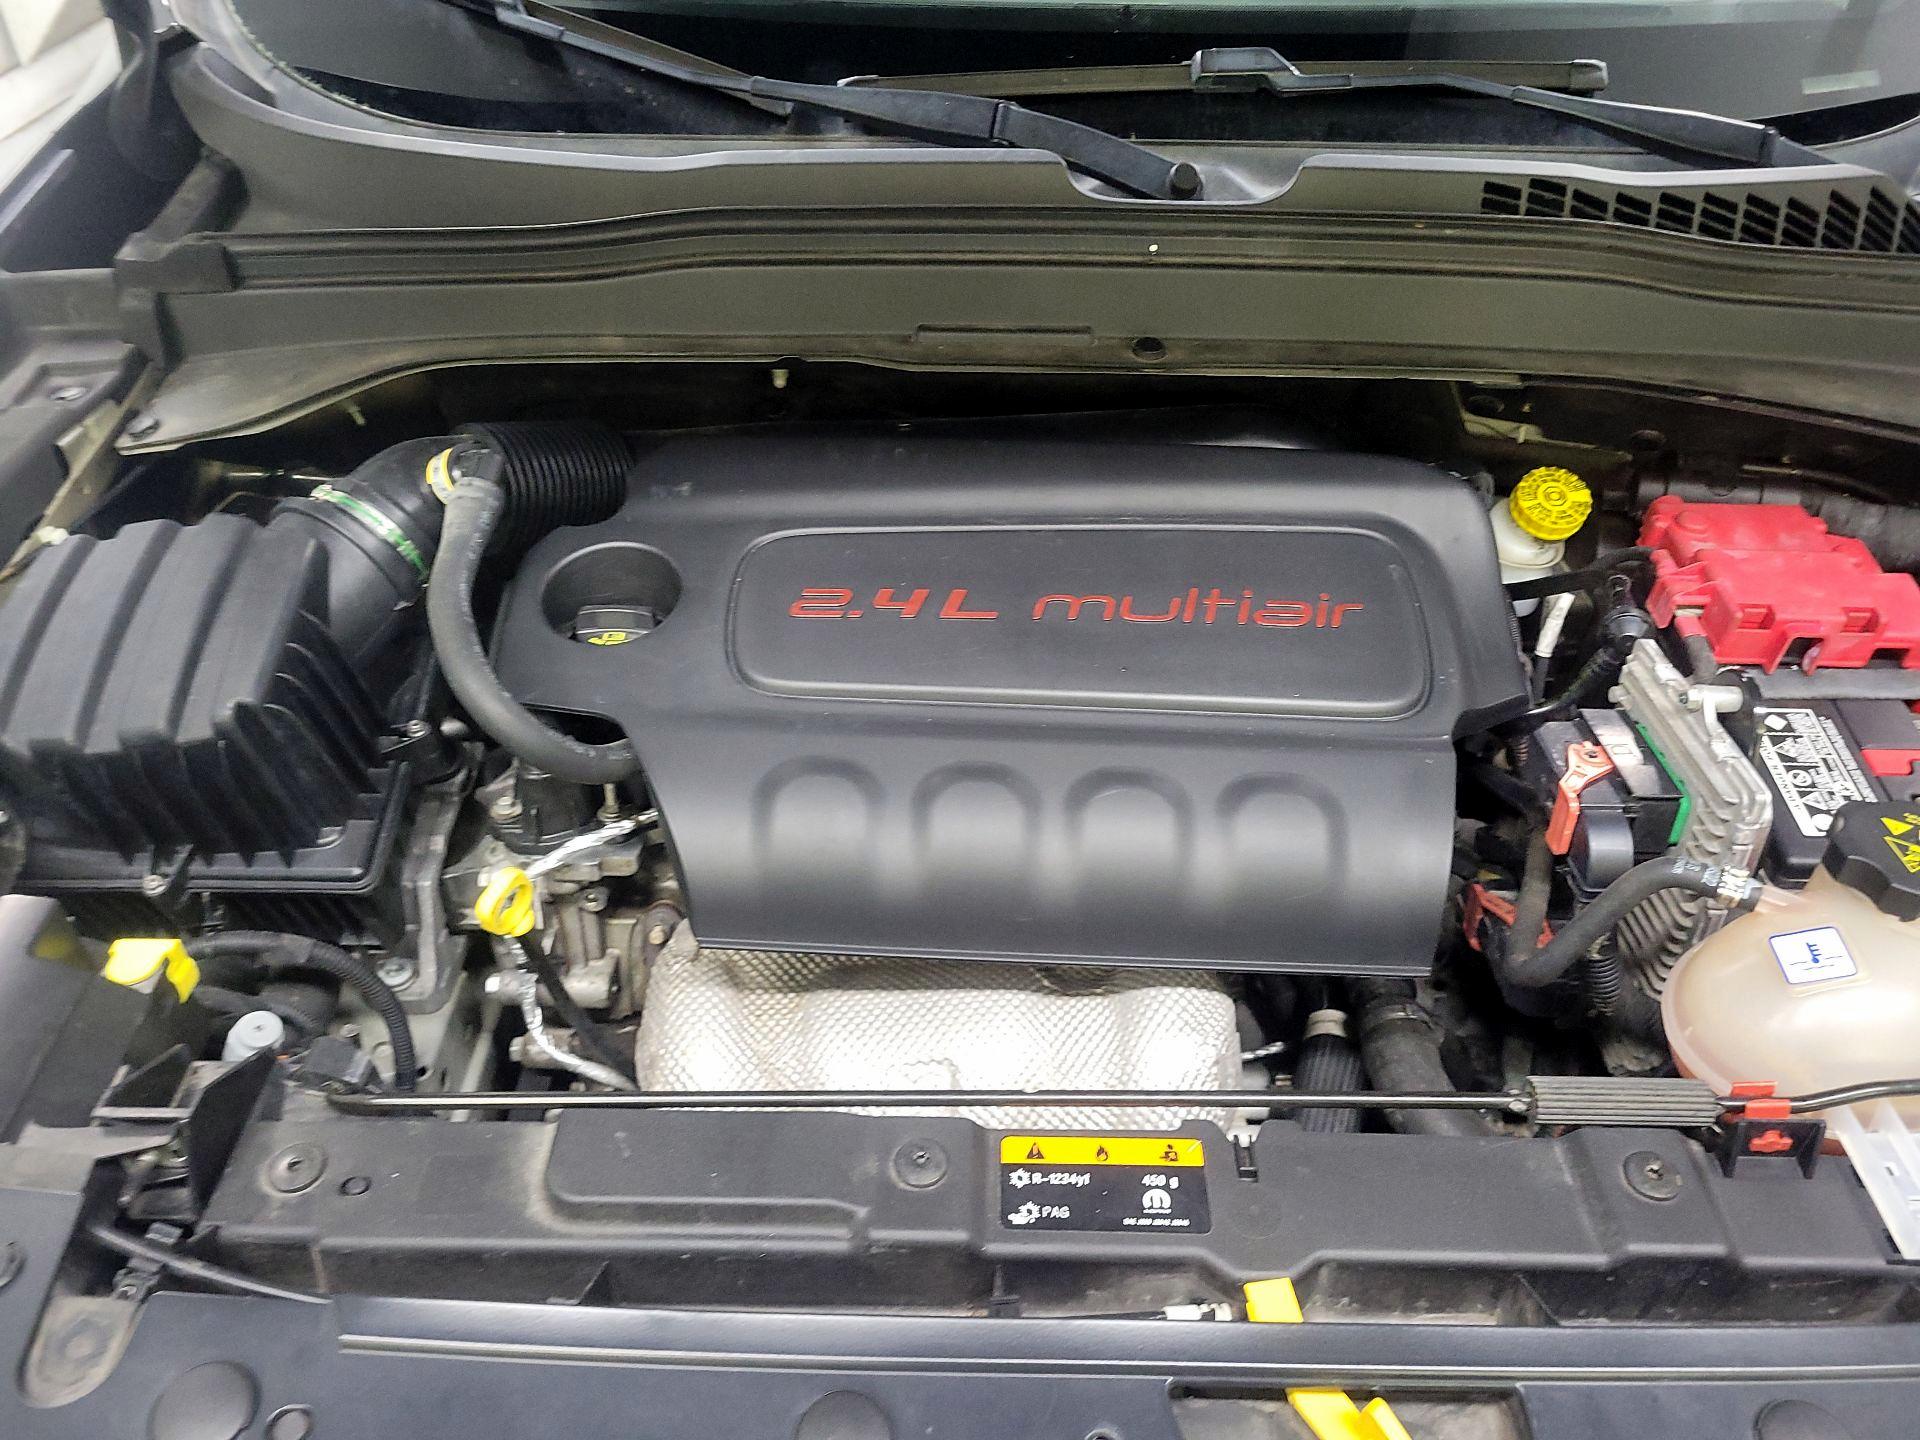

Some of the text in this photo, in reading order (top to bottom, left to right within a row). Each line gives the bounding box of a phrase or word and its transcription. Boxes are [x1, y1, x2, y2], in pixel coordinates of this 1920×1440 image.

[789, 587, 1364, 628] 2.4L multiair
[1041, 1205, 1071, 1219] PAG
